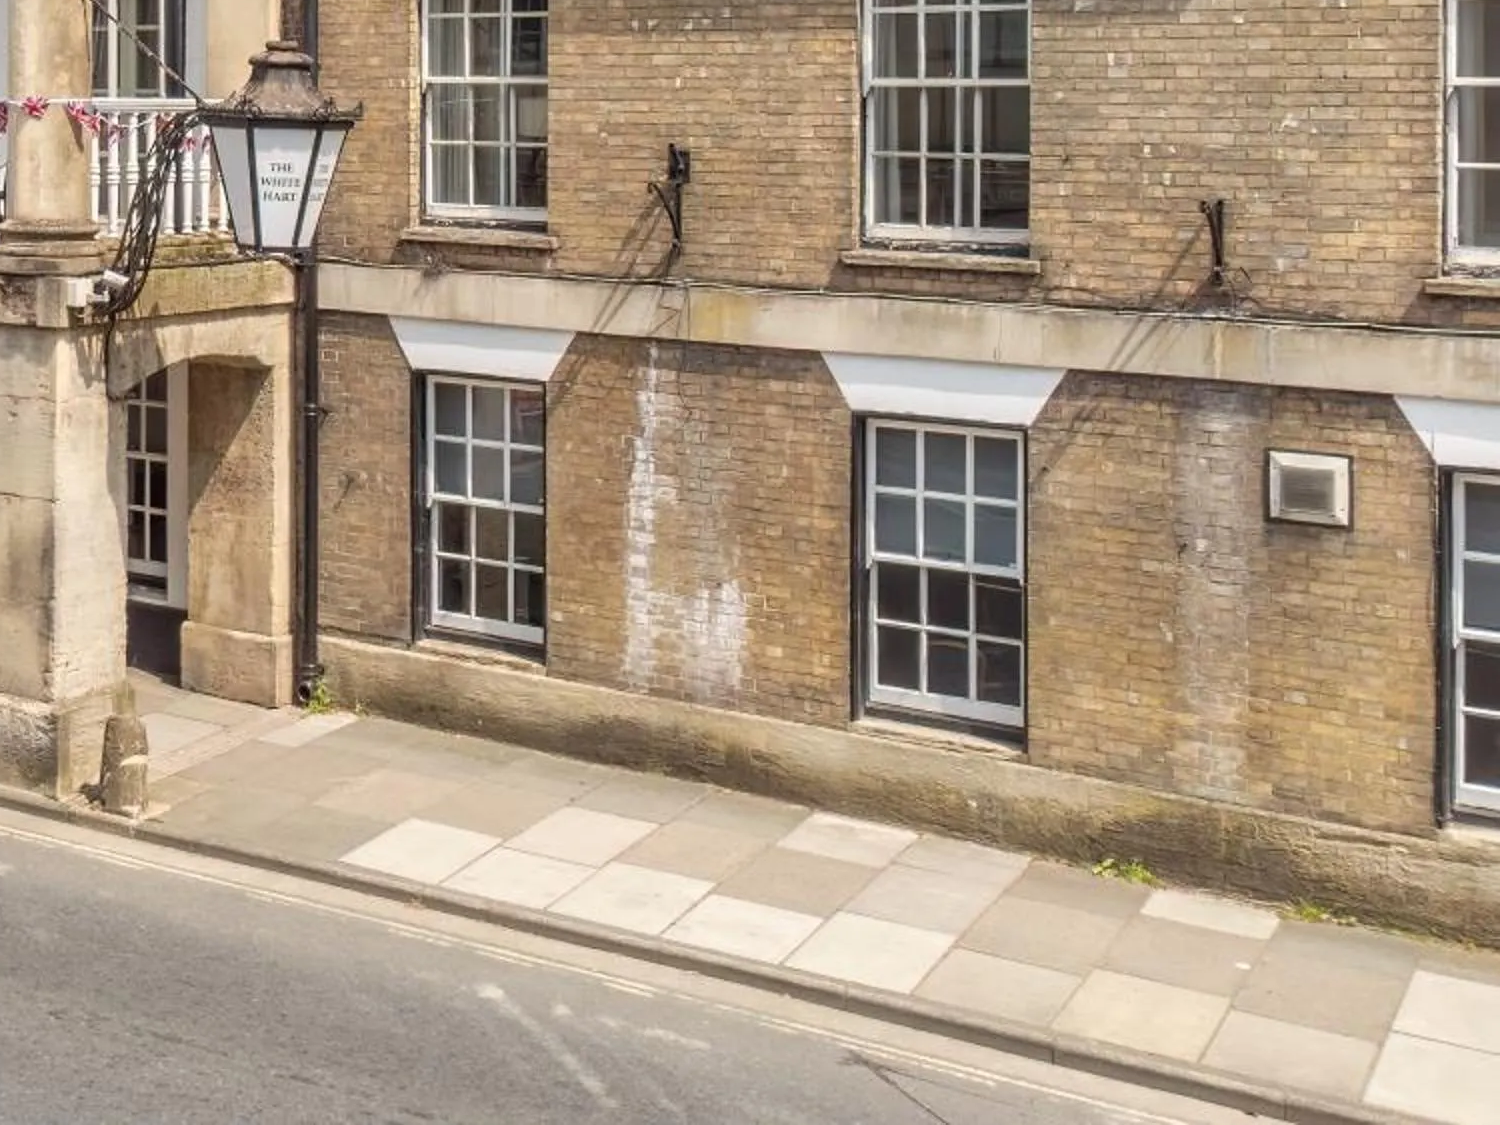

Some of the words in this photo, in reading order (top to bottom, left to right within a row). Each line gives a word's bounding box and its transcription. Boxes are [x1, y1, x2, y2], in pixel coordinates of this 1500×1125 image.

[268, 162, 293, 172] THE
[260, 176, 302, 187] WHITE
[262, 191, 297, 202] HART
